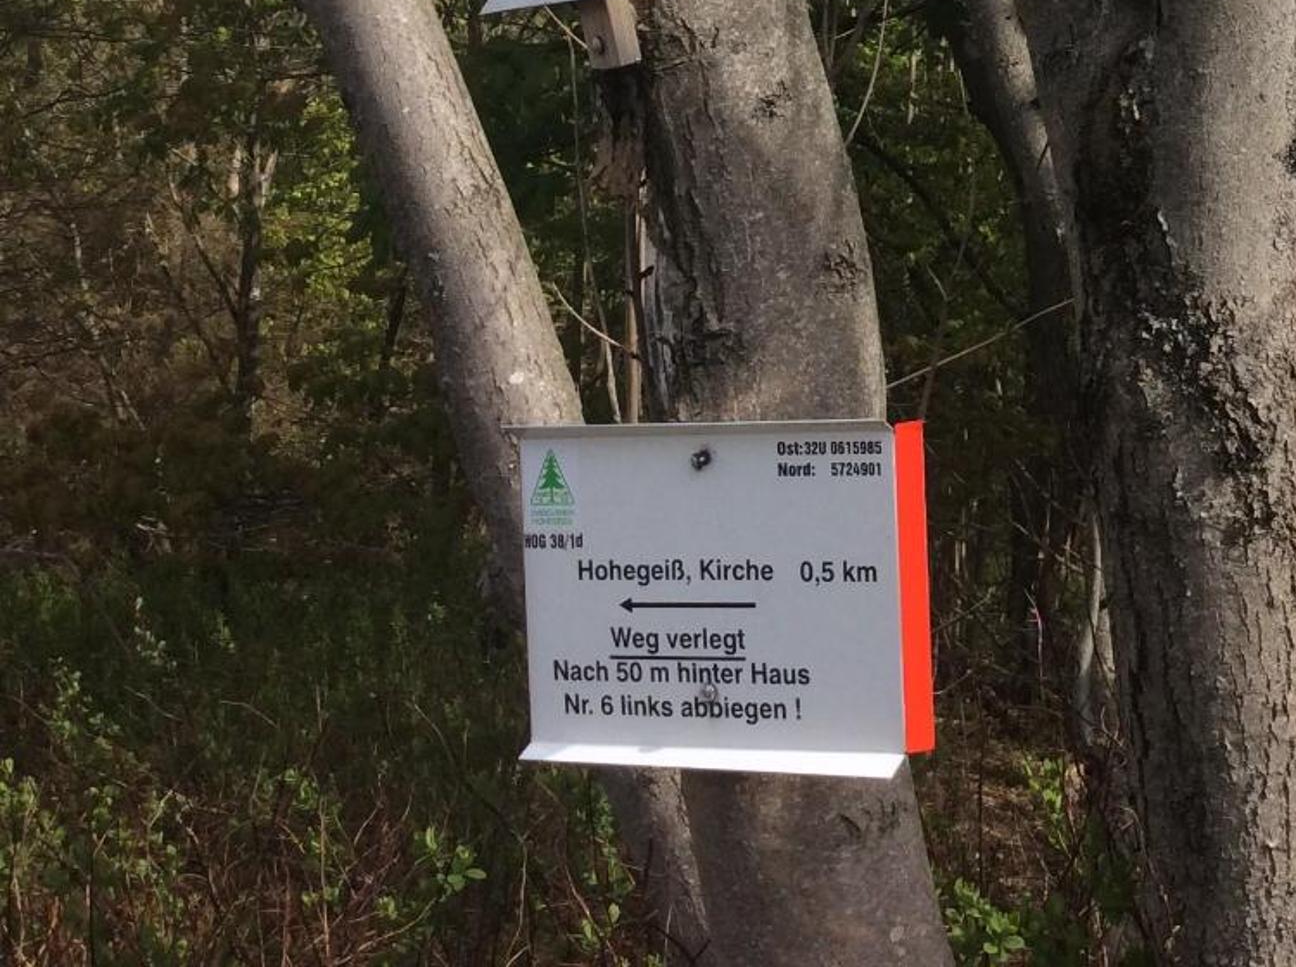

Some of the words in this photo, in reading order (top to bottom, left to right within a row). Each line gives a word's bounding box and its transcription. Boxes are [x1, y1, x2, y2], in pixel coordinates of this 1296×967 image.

[830, 440, 882, 456] 0615985
[777, 462, 816, 477] Nord:
[830, 462, 882, 477] 5724901
[577, 559, 691, 585] Hohegeiß,
[699, 559, 774, 581] Kirche
[799, 561, 835, 585] 0,5
[842, 561, 878, 582] km
[610, 627, 660, 654] Weg
[666, 628, 746, 655] verlegt
[553, 659, 609, 682] Nach
[616, 661, 642, 682] 50
[650, 665, 670, 682] m
[677, 662, 744, 685] hinter
[751, 663, 811, 685] Haus
[564, 694, 594, 716] Nr.
[601, 695, 614, 717] 6
[620, 695, 674, 718] links
[680, 697, 788, 724] abbiegen
